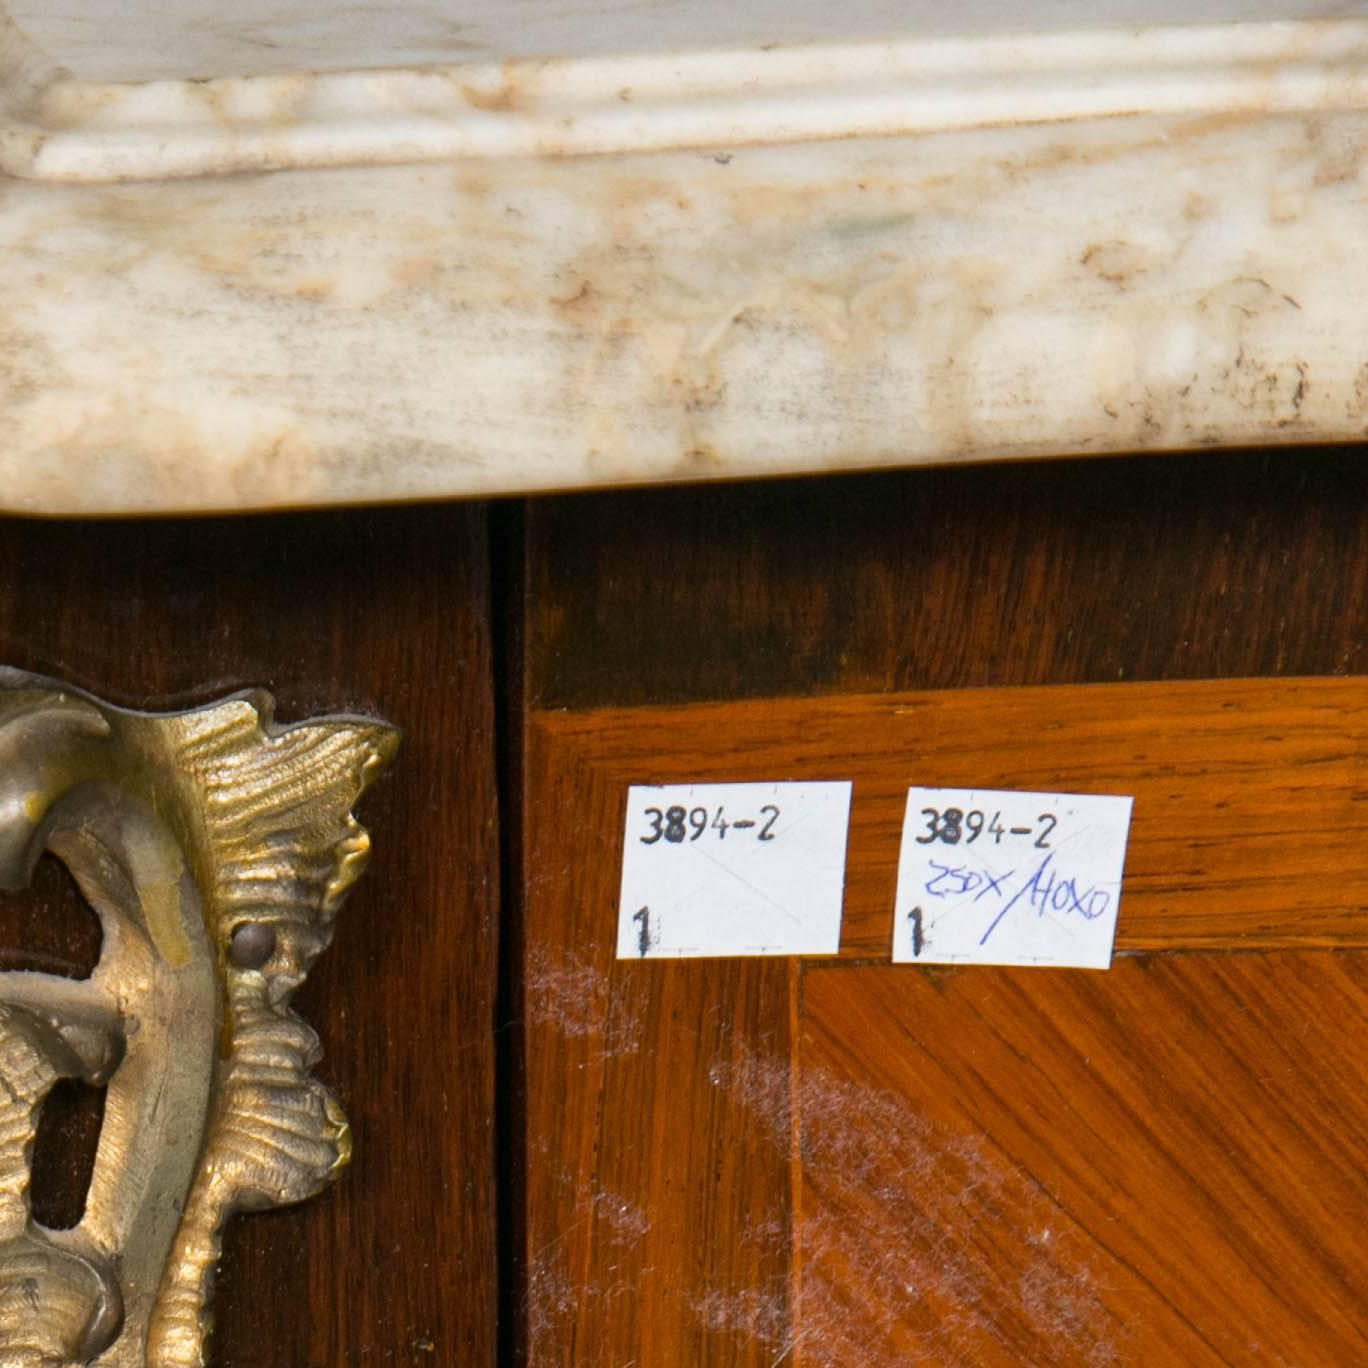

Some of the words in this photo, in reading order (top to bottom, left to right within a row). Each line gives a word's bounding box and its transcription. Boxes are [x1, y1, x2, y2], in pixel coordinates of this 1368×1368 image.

[640, 805, 780, 844] 3894-2
[916, 808, 1057, 848] 3894-2
[633, 905, 651, 957] 1
[908, 906, 923, 957] 1
